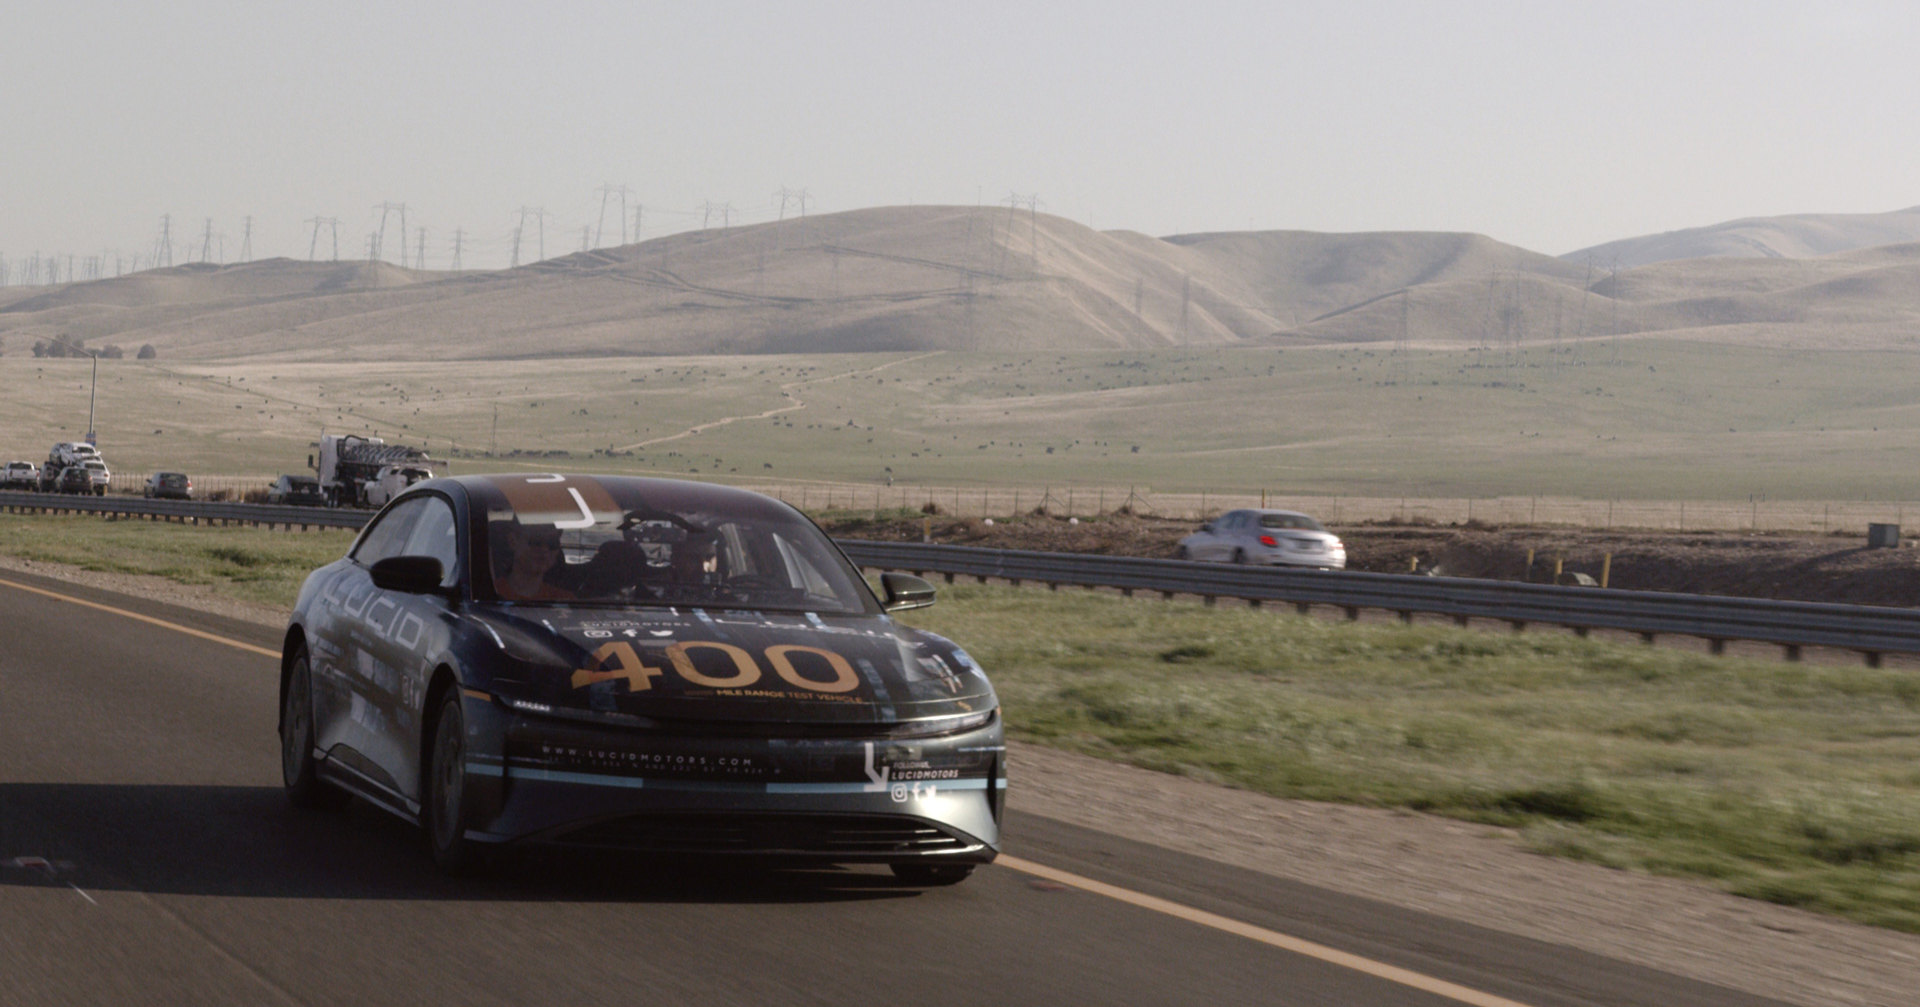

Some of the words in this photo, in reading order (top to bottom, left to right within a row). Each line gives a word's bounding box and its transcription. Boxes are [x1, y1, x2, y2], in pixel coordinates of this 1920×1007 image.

[323, 573, 425, 651] LUCID
[570, 641, 861, 693] 400
[716, 689, 744, 697] MILE
[745, 690, 787, 699] RANGE
[788, 692, 814, 700] TEST
[816, 694, 864, 704] VEHICLE
[542, 745, 752, 766] WWW.LUCIDMOTORS.COM
[891, 769, 959, 781] LUCIDMOTORS
